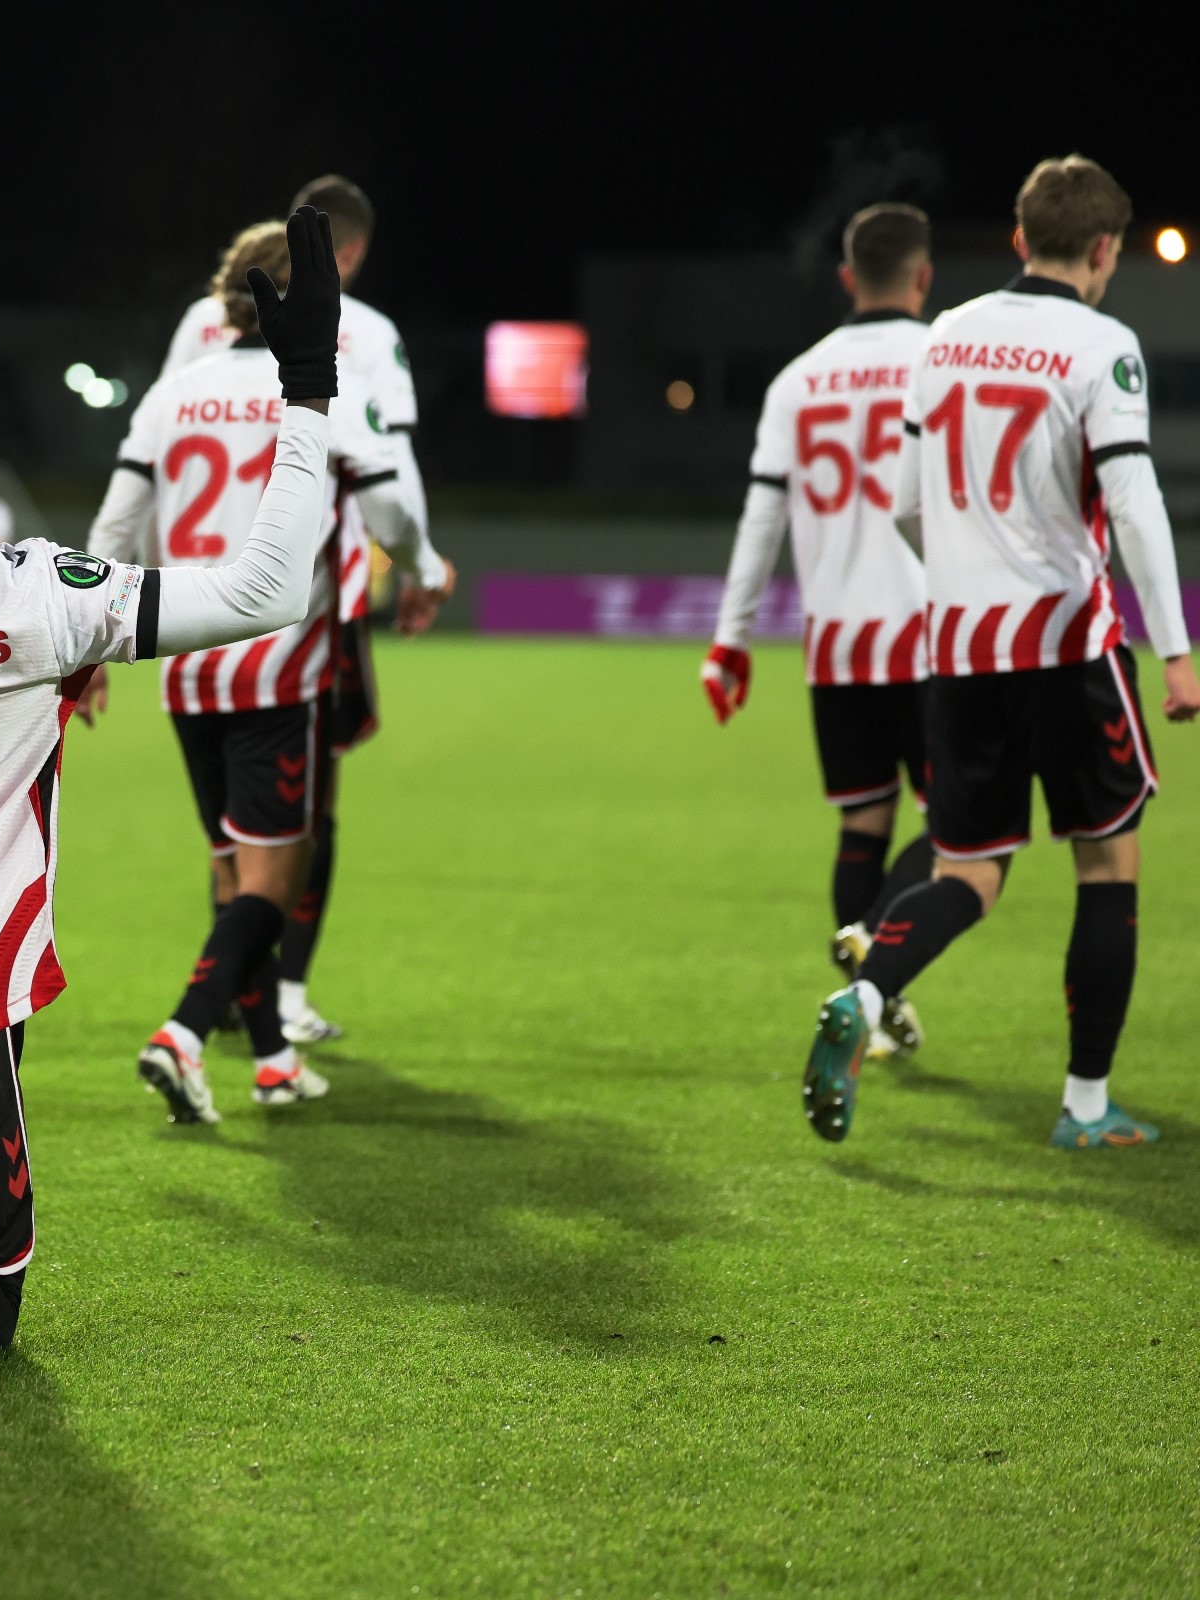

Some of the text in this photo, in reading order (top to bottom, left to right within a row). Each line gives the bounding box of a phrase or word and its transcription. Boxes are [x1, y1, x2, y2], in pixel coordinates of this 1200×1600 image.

[927, 343, 1072, 379] TOMASSON
[177, 397, 282, 424] HOLSE
[925, 381, 1050, 516] 17
[796, 399, 904, 515] 55
